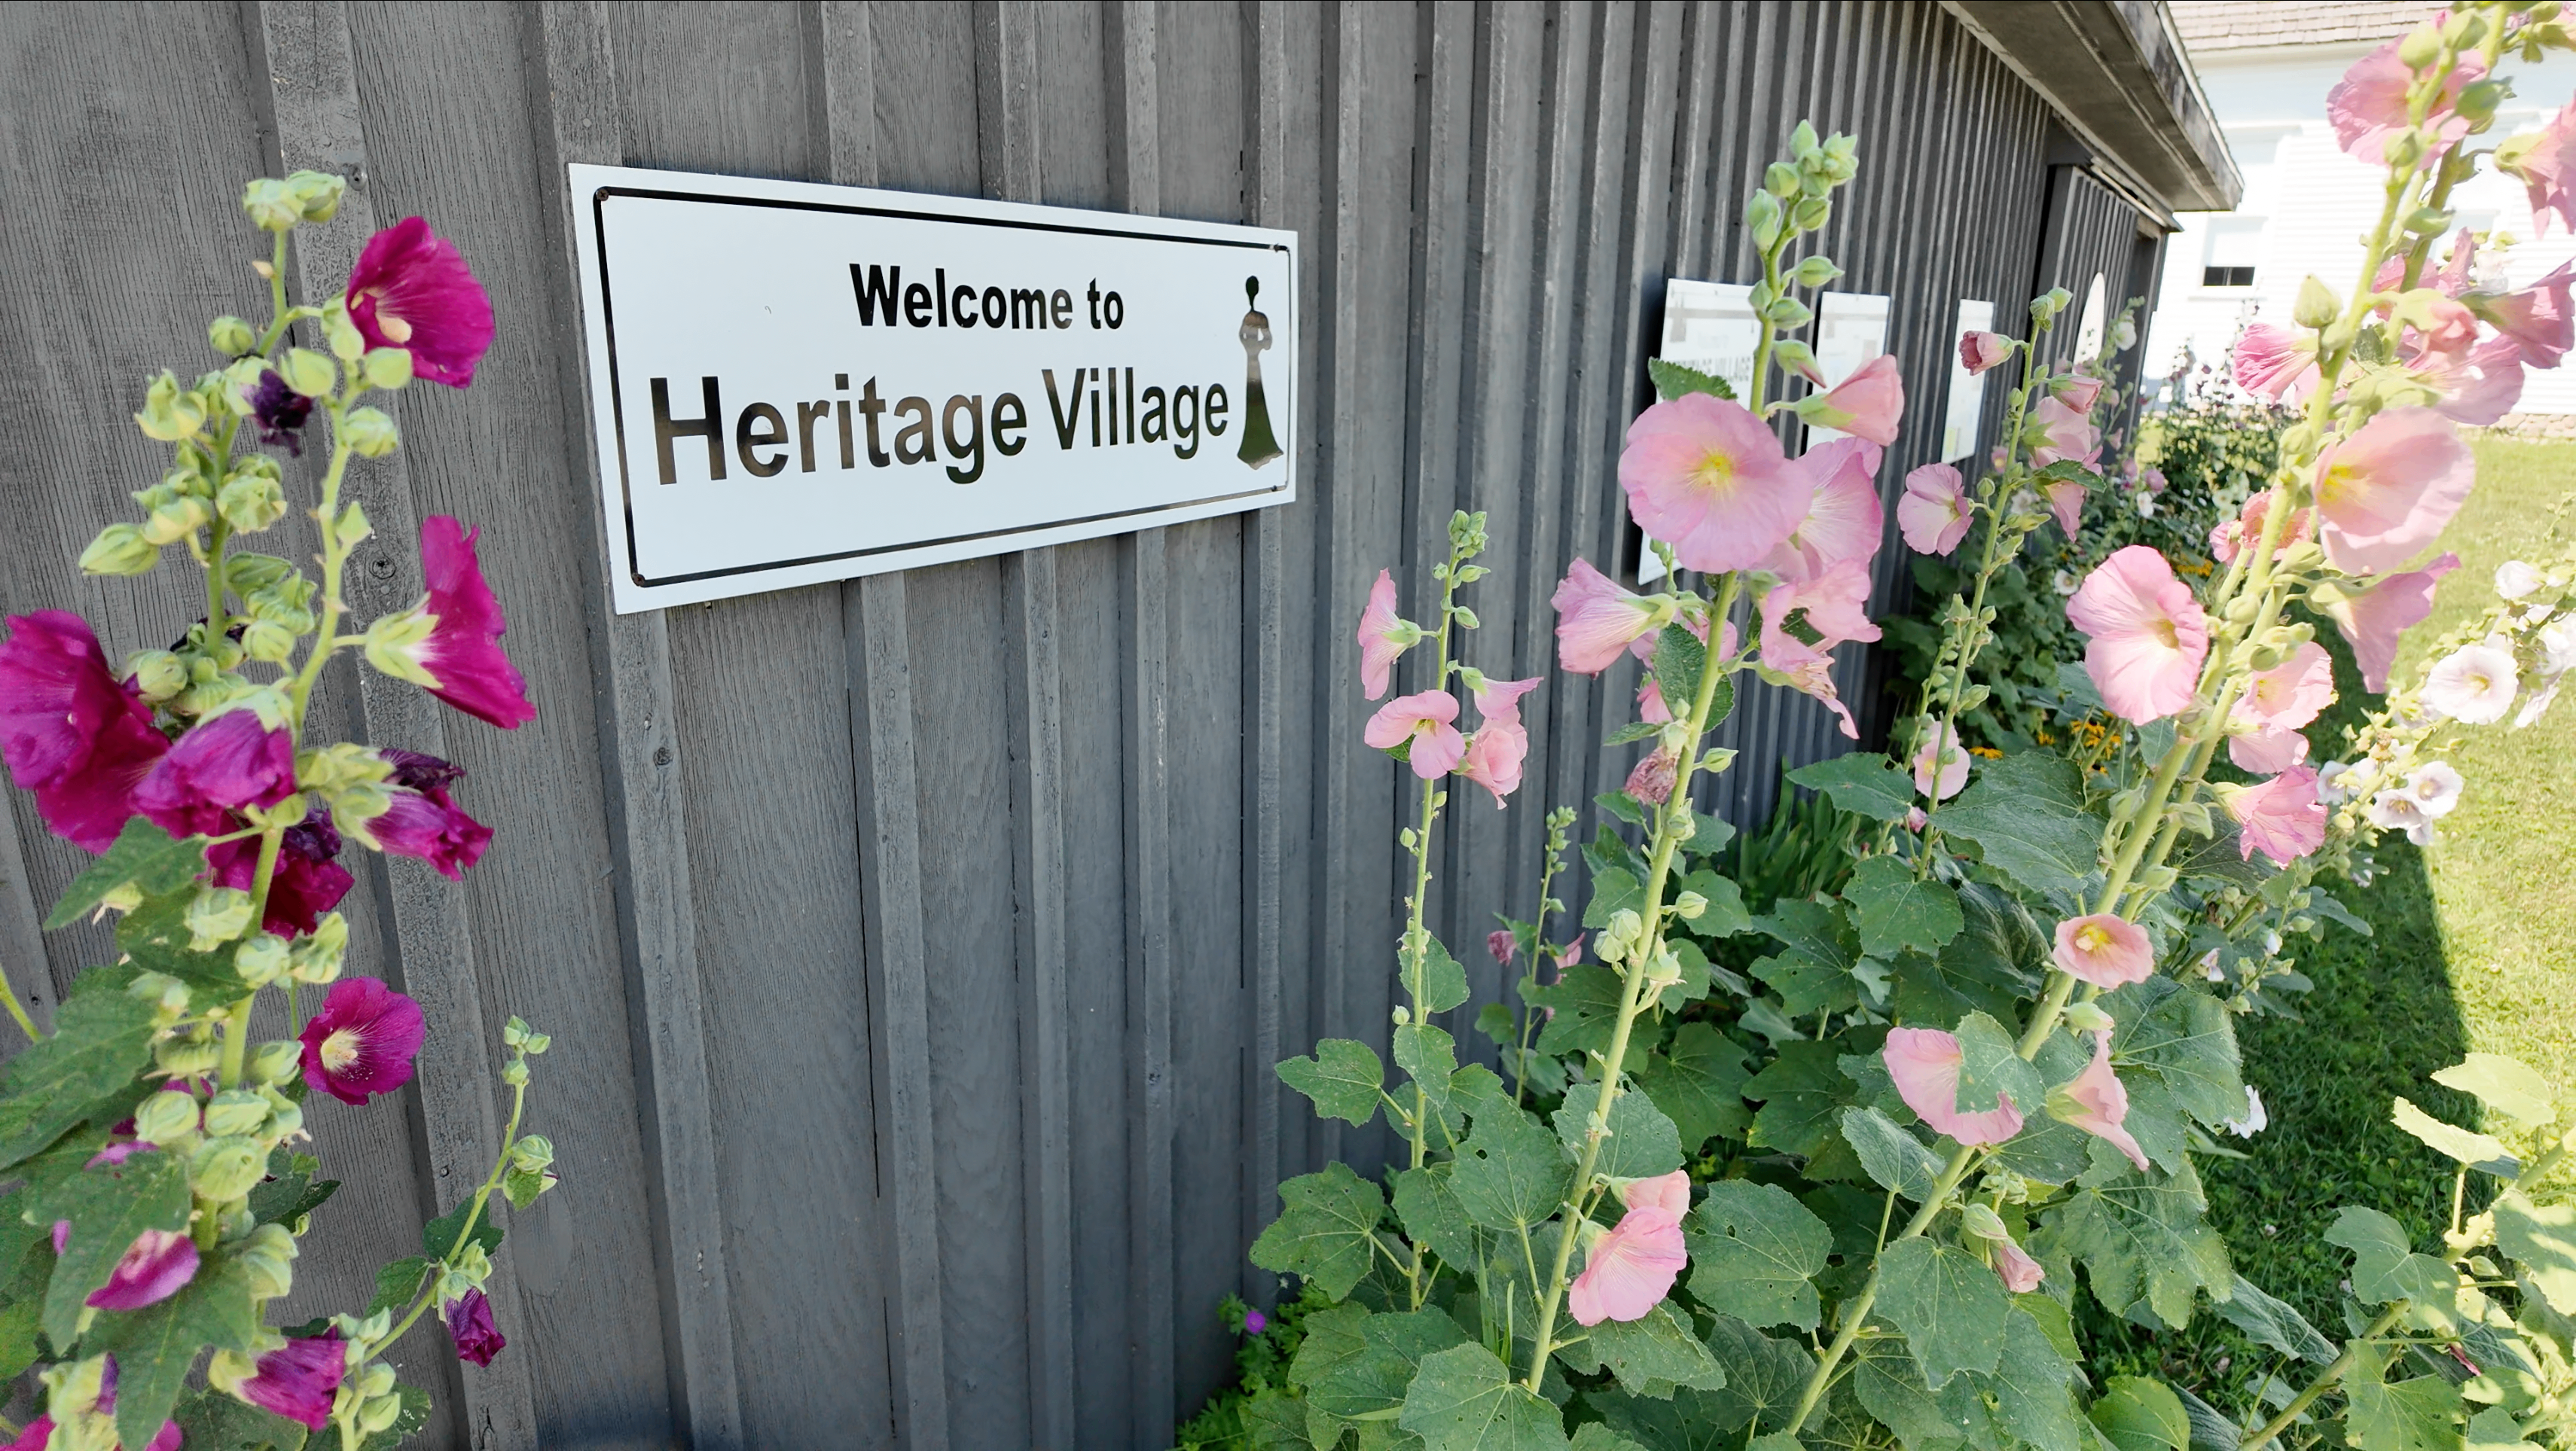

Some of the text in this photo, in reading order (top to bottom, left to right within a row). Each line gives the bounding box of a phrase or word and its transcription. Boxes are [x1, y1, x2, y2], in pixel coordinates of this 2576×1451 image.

[848, 263, 1125, 330] Welcome to
[649, 366, 1229, 486] Heritage Village
